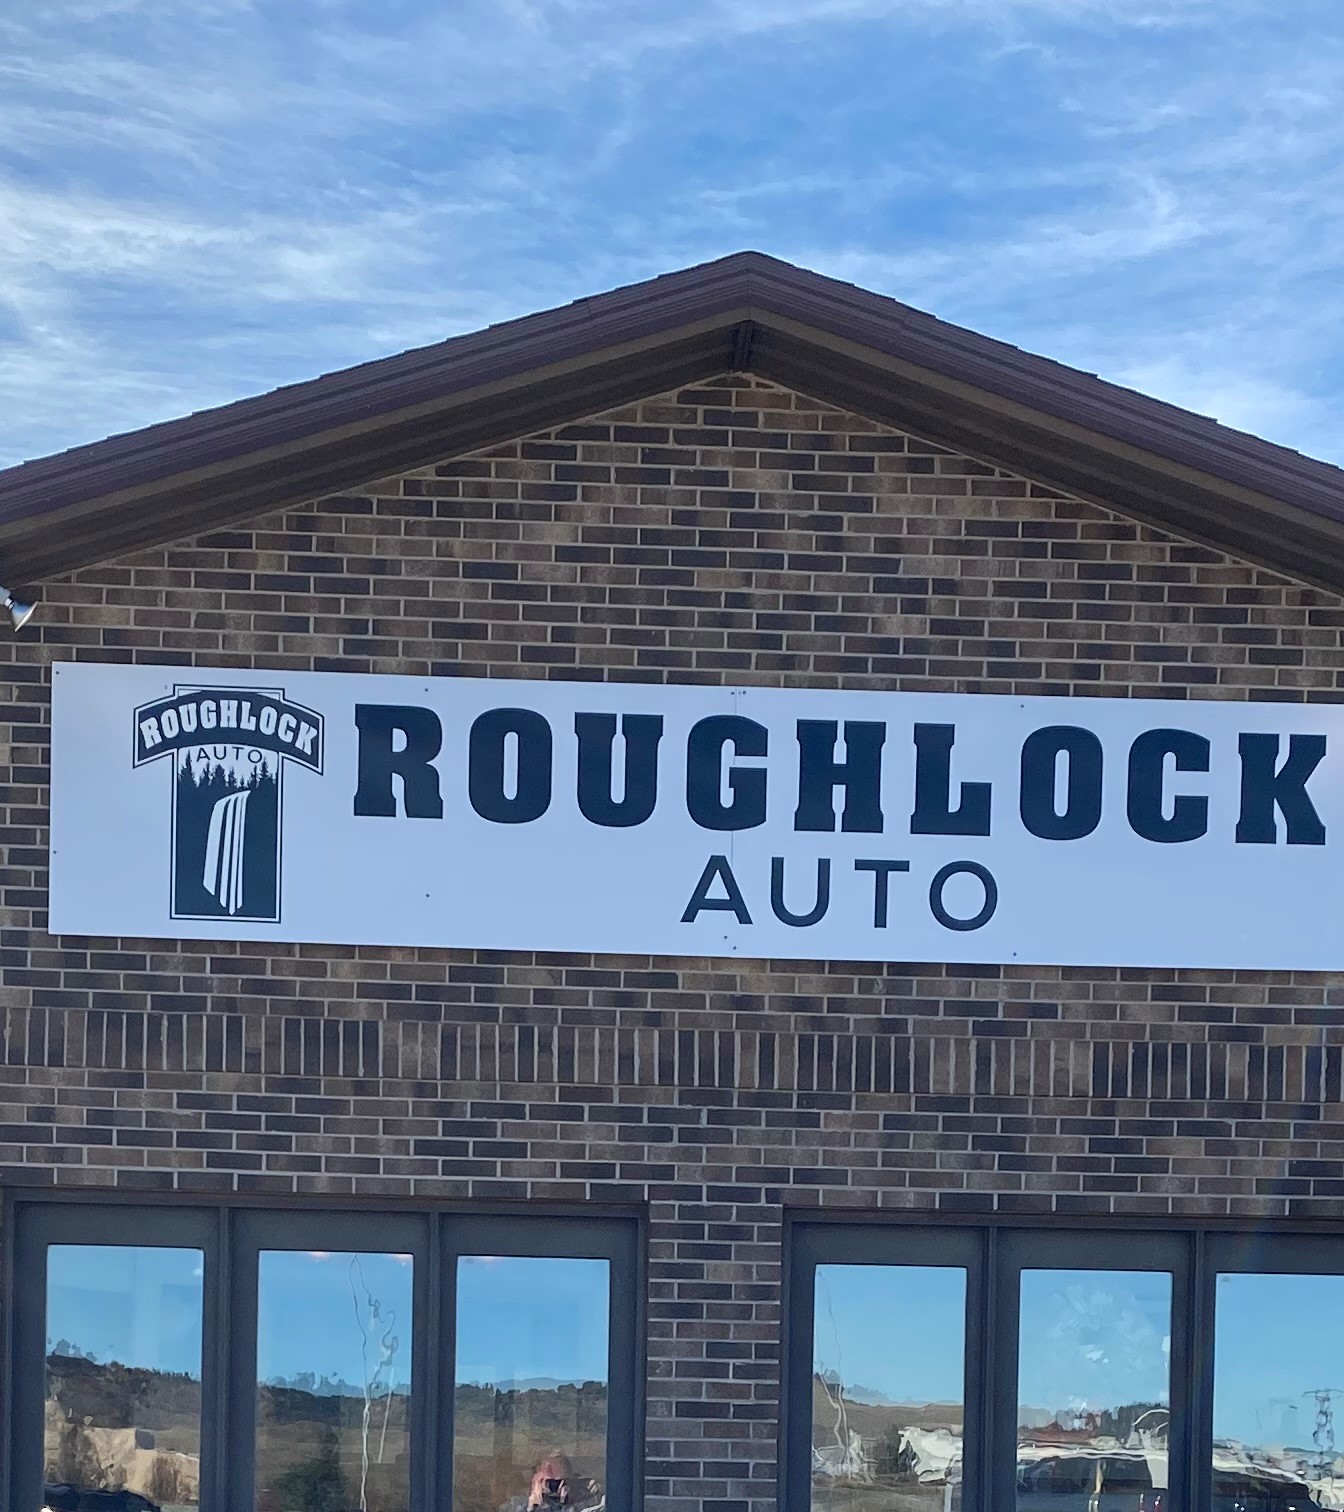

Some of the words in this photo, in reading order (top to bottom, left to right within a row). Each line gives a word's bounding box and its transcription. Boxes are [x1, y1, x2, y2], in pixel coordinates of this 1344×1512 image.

[139, 699, 318, 756] ROUGHLOCK
[195, 746, 264, 764] AUTO
[353, 703, 1329, 846] ROUGHLOCK
[680, 854, 999, 932] AUTO
